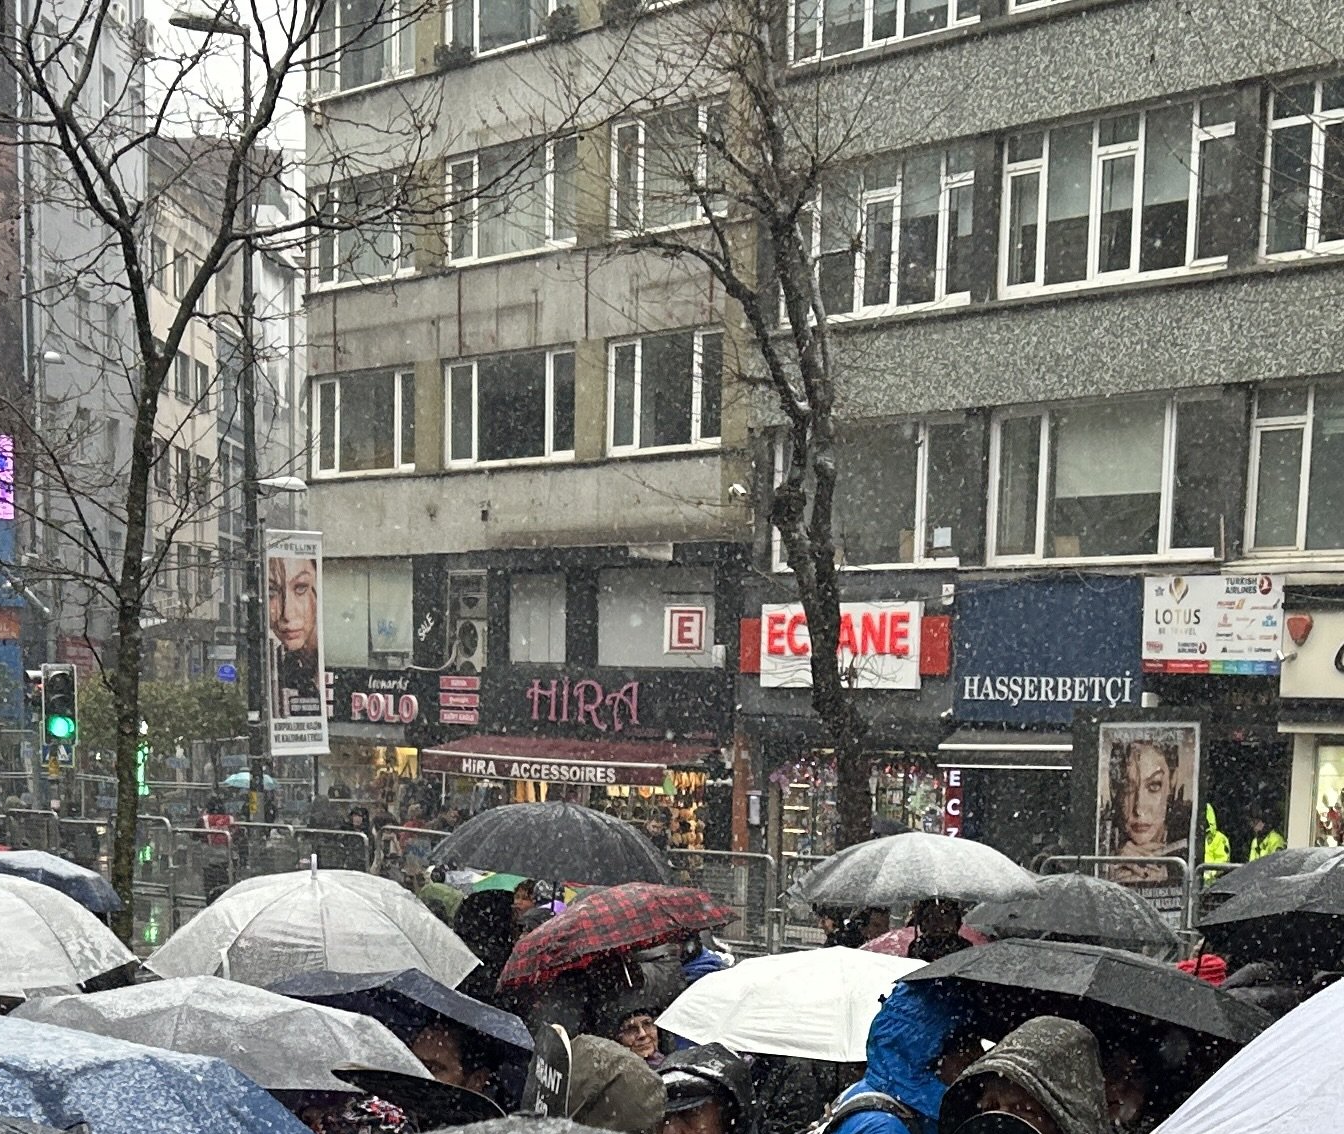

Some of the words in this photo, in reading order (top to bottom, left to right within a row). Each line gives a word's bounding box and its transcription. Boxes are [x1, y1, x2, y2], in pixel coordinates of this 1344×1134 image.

[1225, 577, 1257, 585] TURKISH
[1225, 585, 1257, 594] AIRLINES
[678, 616, 694, 644] E
[1155, 608, 1201, 625] LOTUS
[767, 611, 910, 656] ECANE
[963, 670, 1133, 708] HASŞERBETÇİ
[351, 692, 418, 724] POLO
